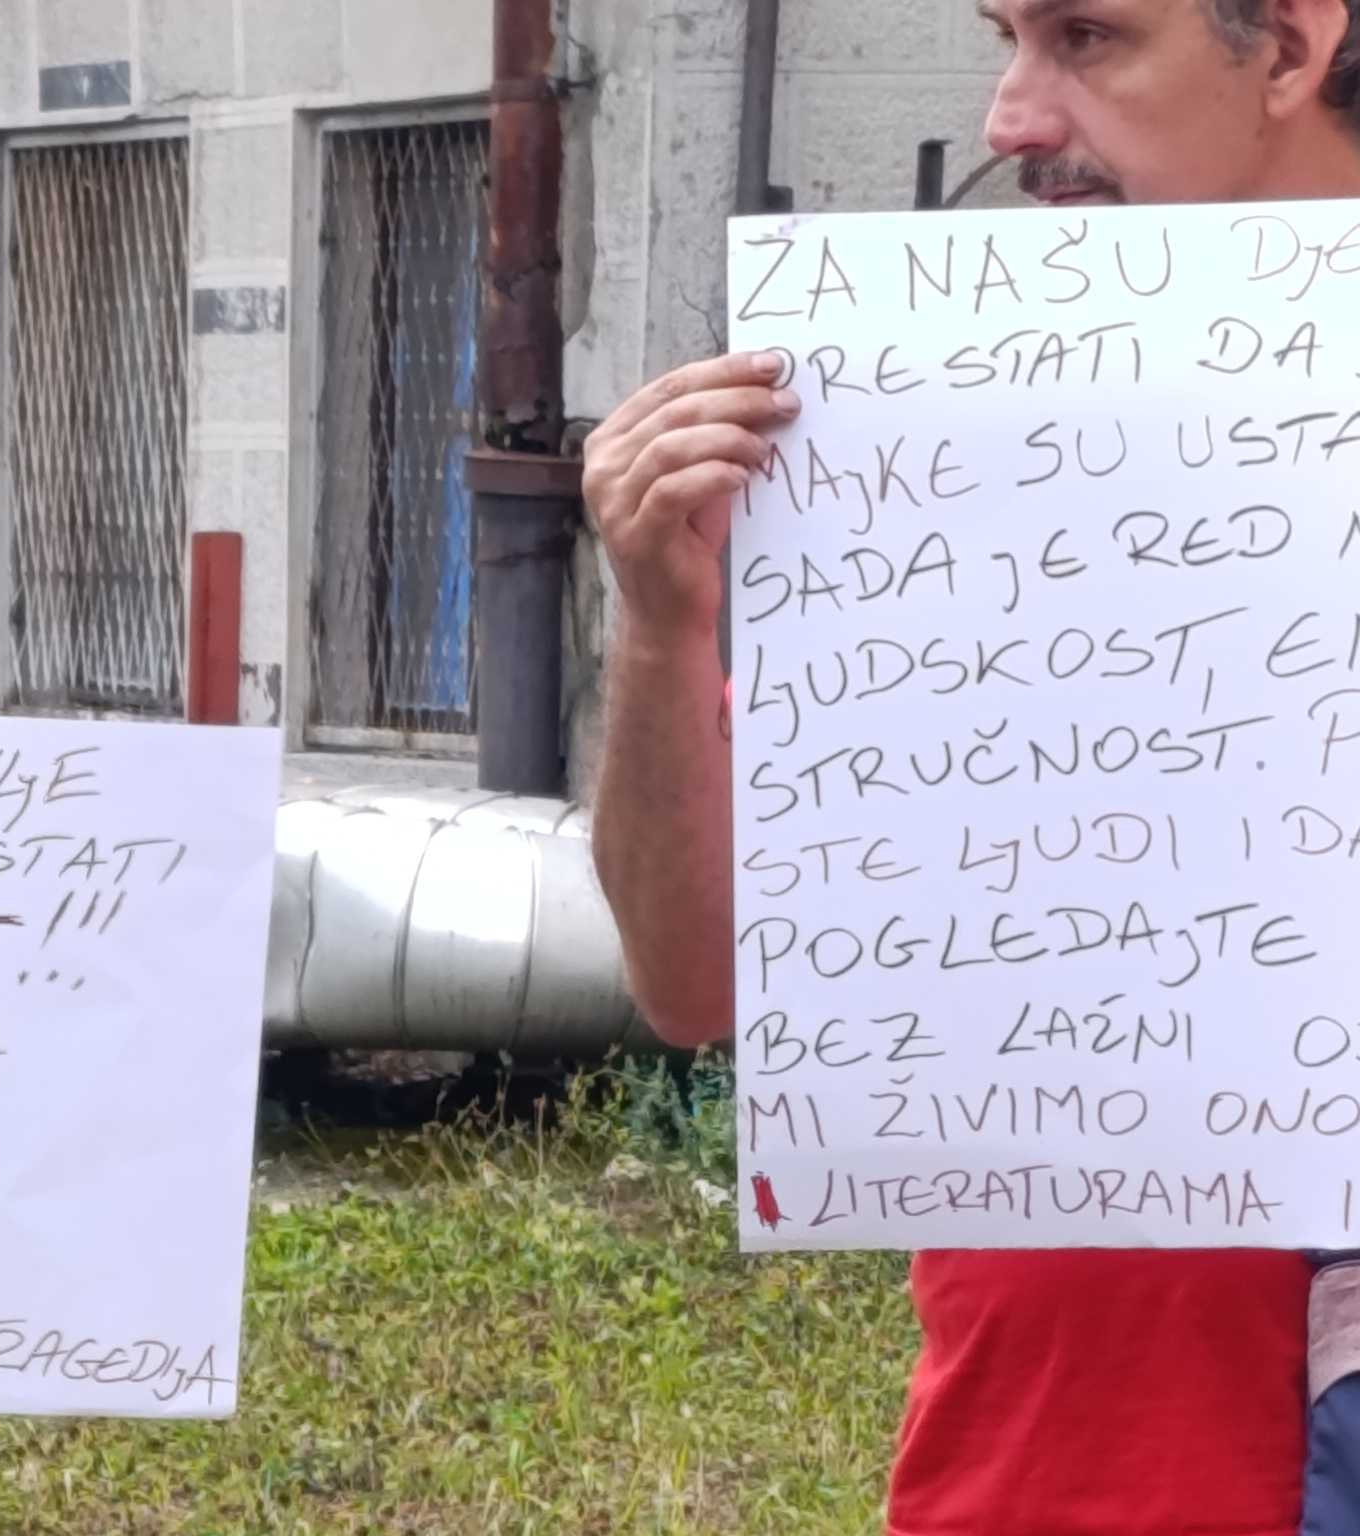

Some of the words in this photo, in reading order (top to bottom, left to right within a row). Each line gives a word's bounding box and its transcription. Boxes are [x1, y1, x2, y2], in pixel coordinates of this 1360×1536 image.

[738, 234, 856, 320] ZA
[904, 218, 1172, 314] NAŠU
[1197, 317, 1323, 378] DA
[744, 436, 980, 535] MAJKE
[1016, 420, 1128, 488] SU
[742, 532, 956, 624] SADA
[990, 528, 1088, 614] JE
[1112, 504, 1293, 568] RED
[748, 718, 1276, 823] STRUČNOST.
[742, 836, 922, 897] STE
[958, 814, 1180, 893] LJUDI
[739, 901, 1318, 993] POGLEDAJTE
[745, 1008, 946, 1076] BEZ
[746, 1092, 826, 1153] MI
[869, 1072, 1149, 1139] ŽIVIMO
[1205, 1086, 1360, 1137] ONO
[809, 1164, 1284, 1228] LITERATURAMA
